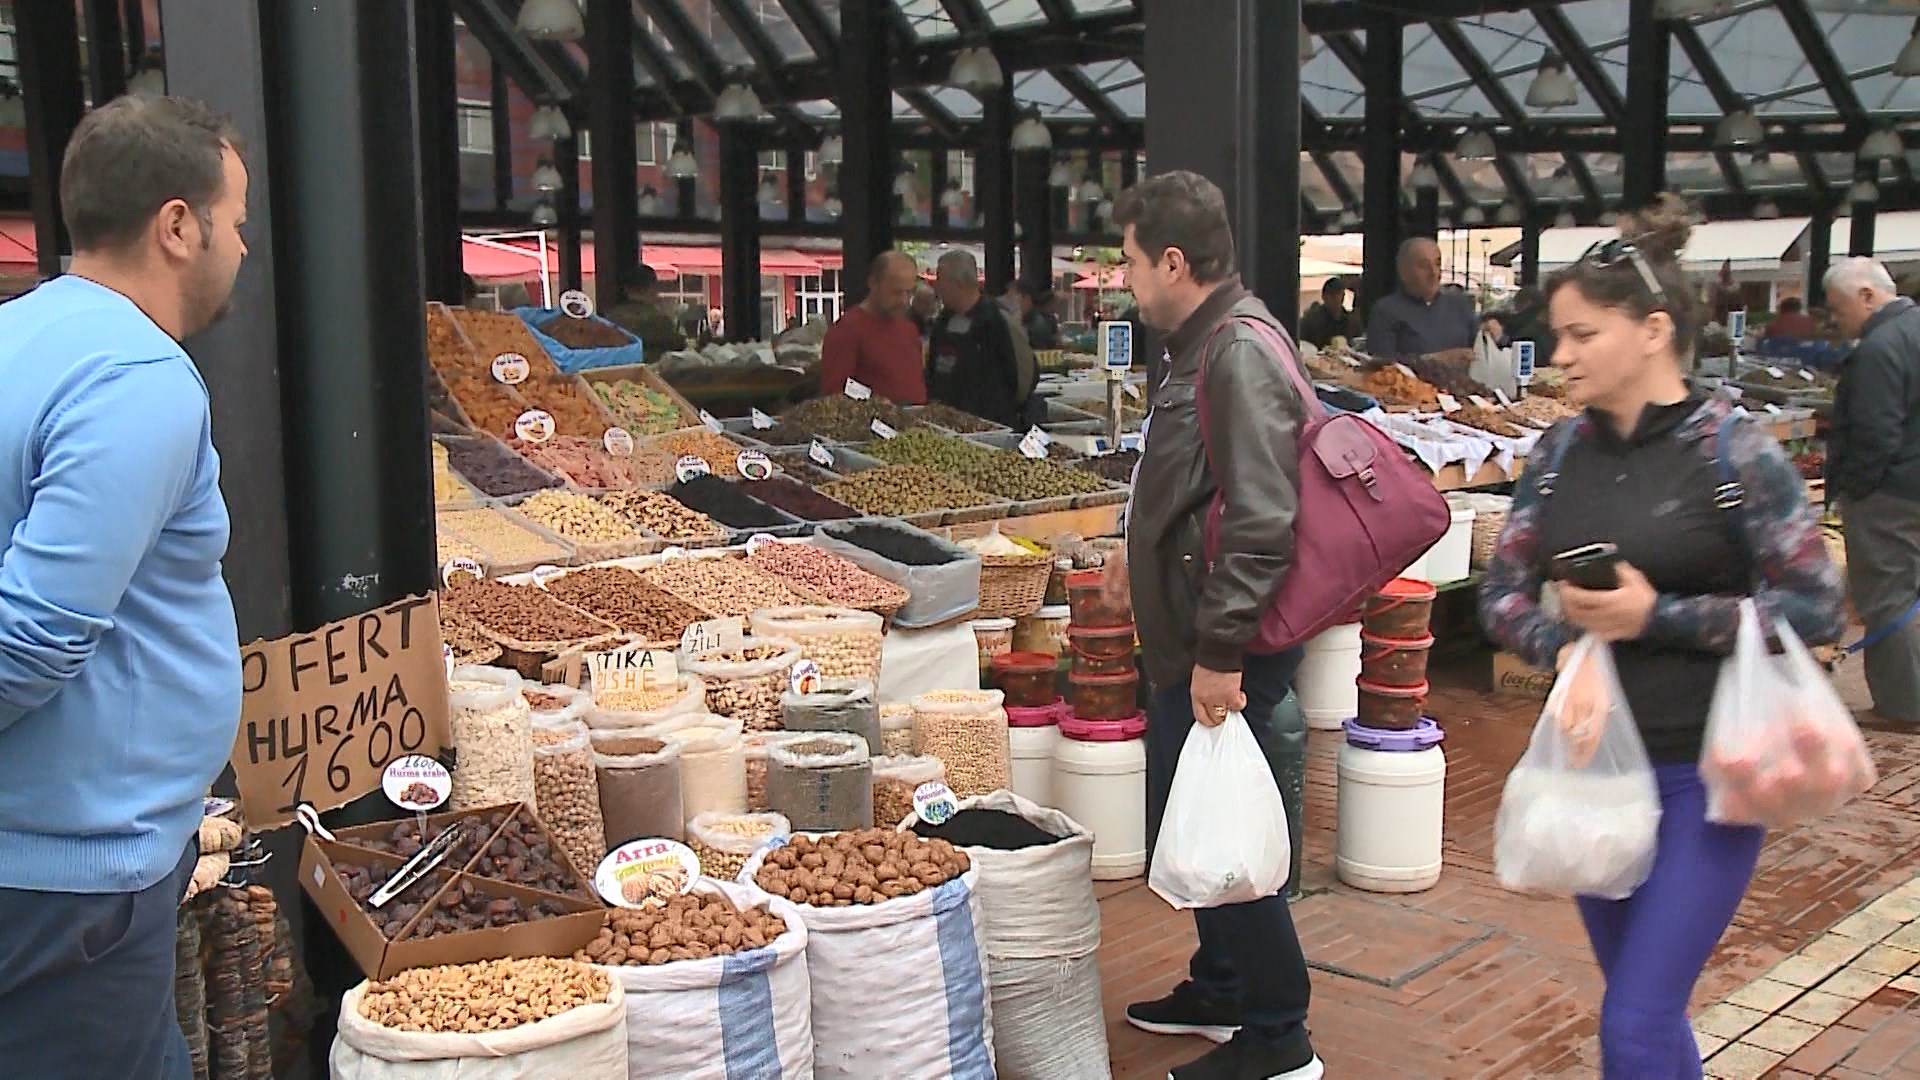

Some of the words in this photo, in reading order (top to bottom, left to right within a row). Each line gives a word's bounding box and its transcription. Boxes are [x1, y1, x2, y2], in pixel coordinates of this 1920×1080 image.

[247, 673, 408, 764] HURMA
[278, 707, 425, 813] 1600
[389, 768, 420, 777] Hurma
[615, 843, 670, 864] Arra
